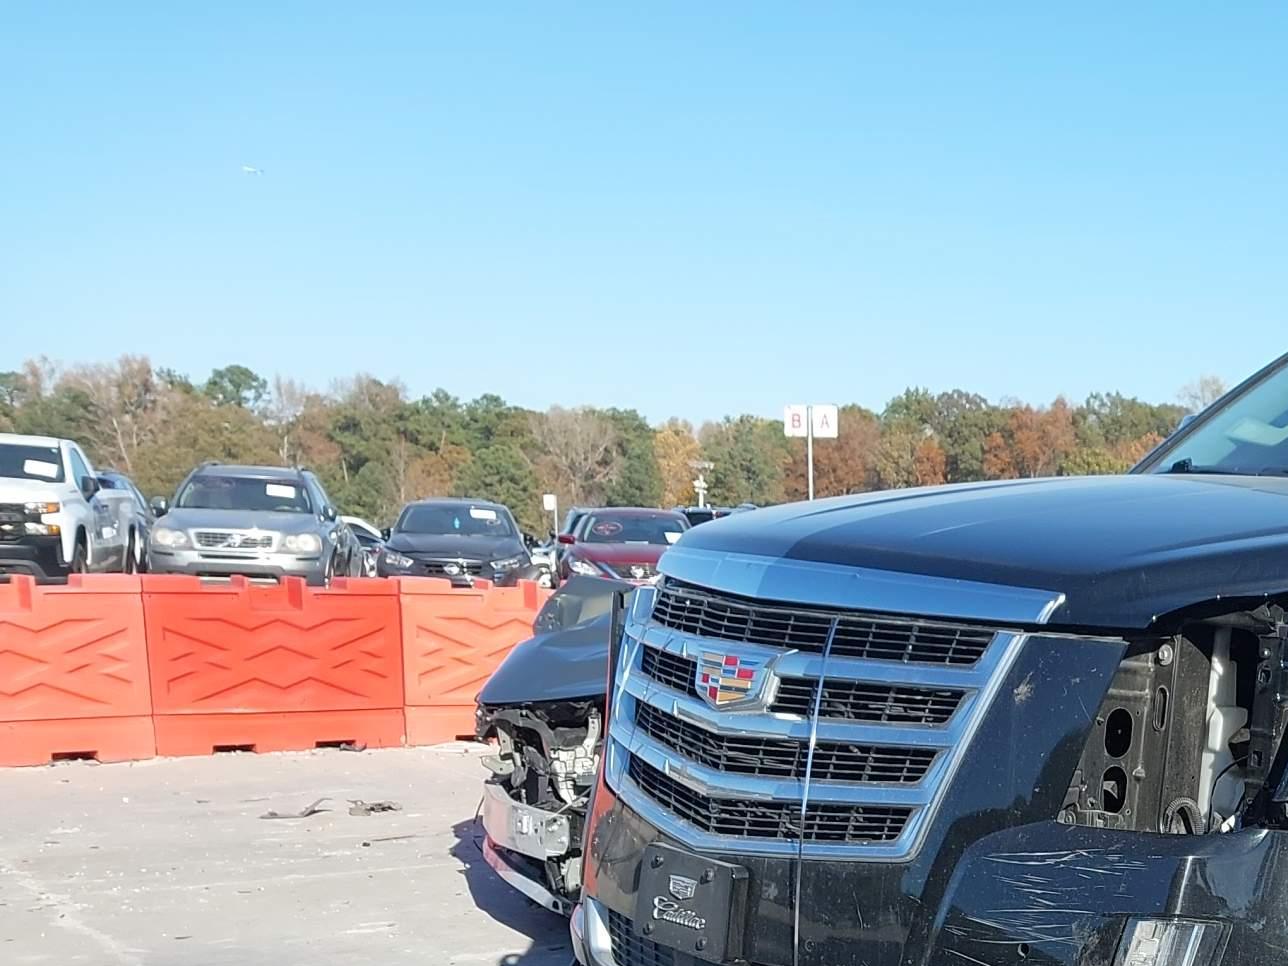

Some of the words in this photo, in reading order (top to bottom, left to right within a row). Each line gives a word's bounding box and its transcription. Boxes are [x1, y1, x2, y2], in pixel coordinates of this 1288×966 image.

[791, 413, 802, 429] B
[820, 413, 831, 429] A
[652, 895, 706, 930] Cadillac
